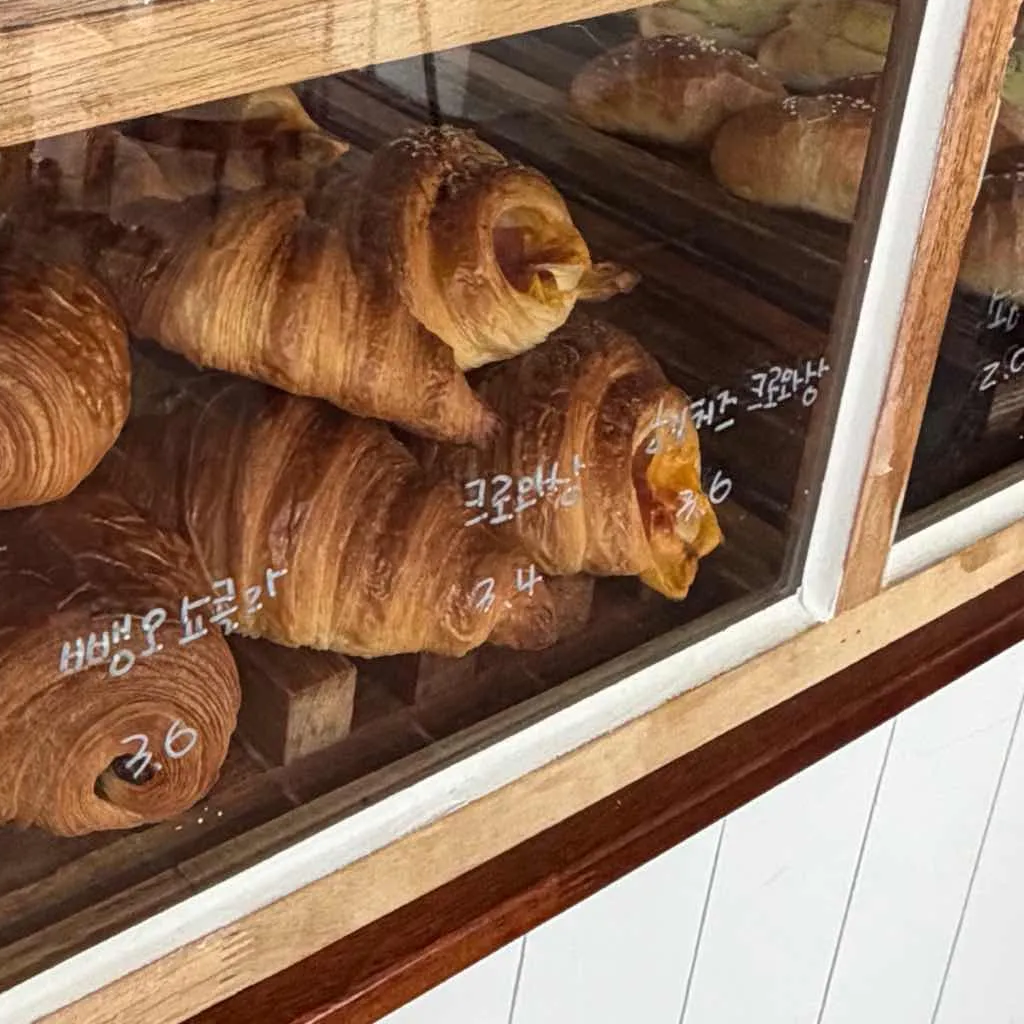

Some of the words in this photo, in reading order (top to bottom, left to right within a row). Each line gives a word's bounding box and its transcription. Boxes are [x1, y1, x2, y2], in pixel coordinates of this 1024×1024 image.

[463, 453, 586, 527] 크로와상
[470, 563, 544, 613] 3.4
[119, 718, 198, 780] 3.6
